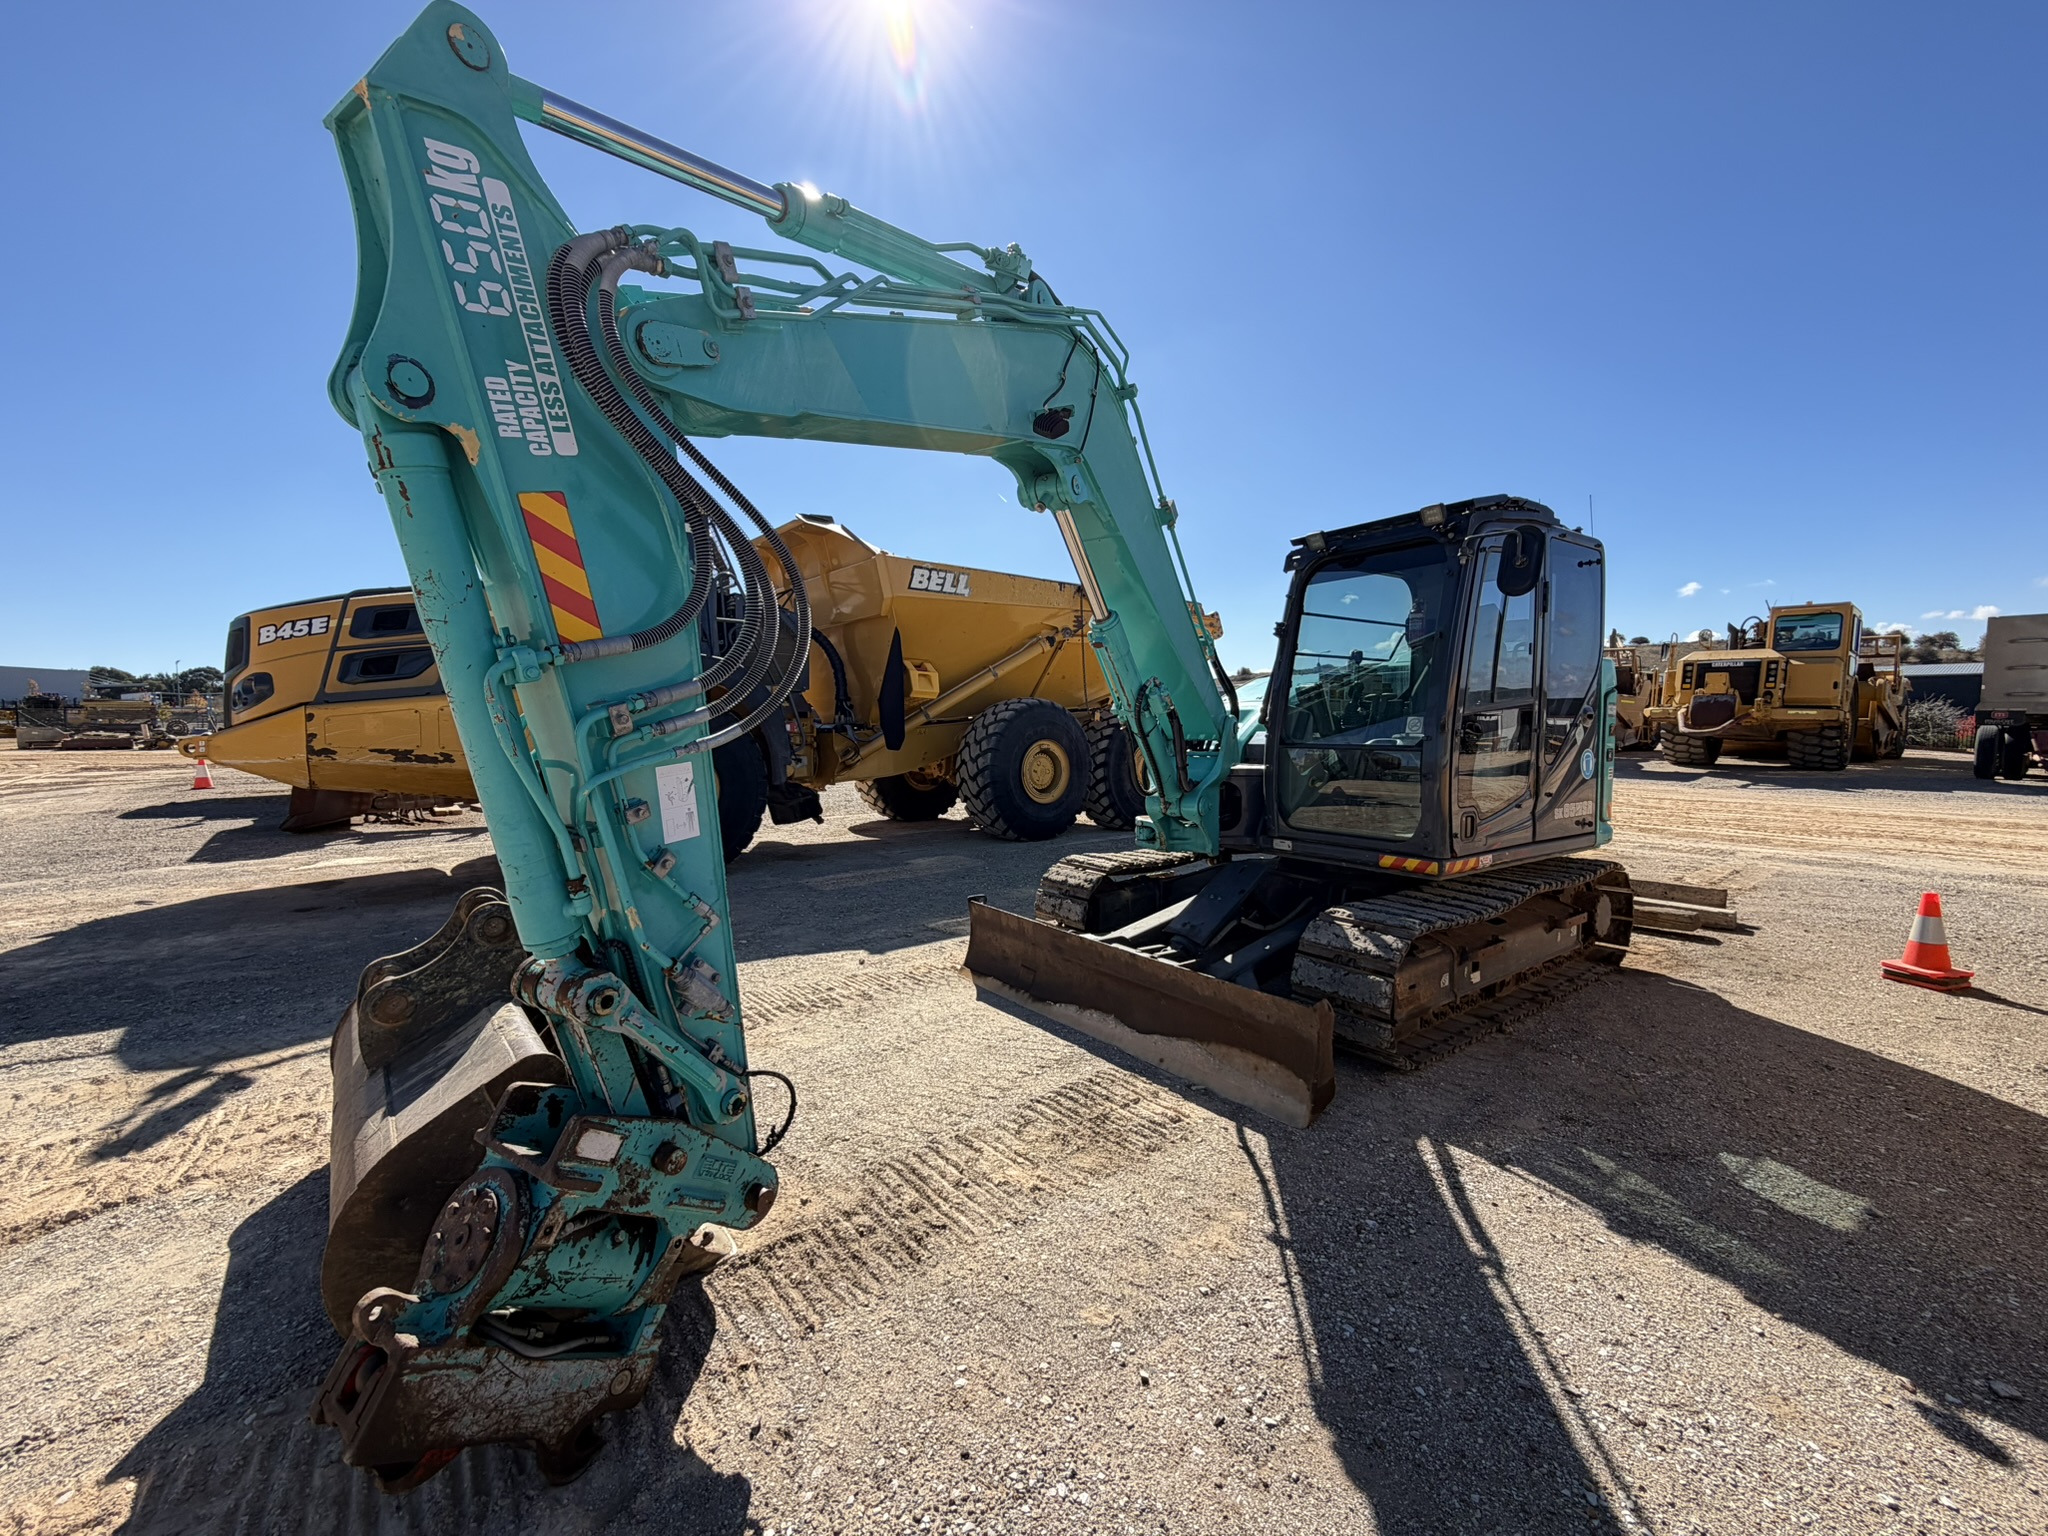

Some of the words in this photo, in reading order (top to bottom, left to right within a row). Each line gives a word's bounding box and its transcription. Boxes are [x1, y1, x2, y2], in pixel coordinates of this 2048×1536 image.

[424, 137, 513, 317] 650kg
[491, 203, 557, 377] ATTACHMENTS
[484, 376, 523, 438] RATED
[505, 359, 552, 456] CAPACITY
[540, 381, 572, 434] LESS
[909, 566, 970, 597] BELL
[259, 616, 329, 645] B45E
